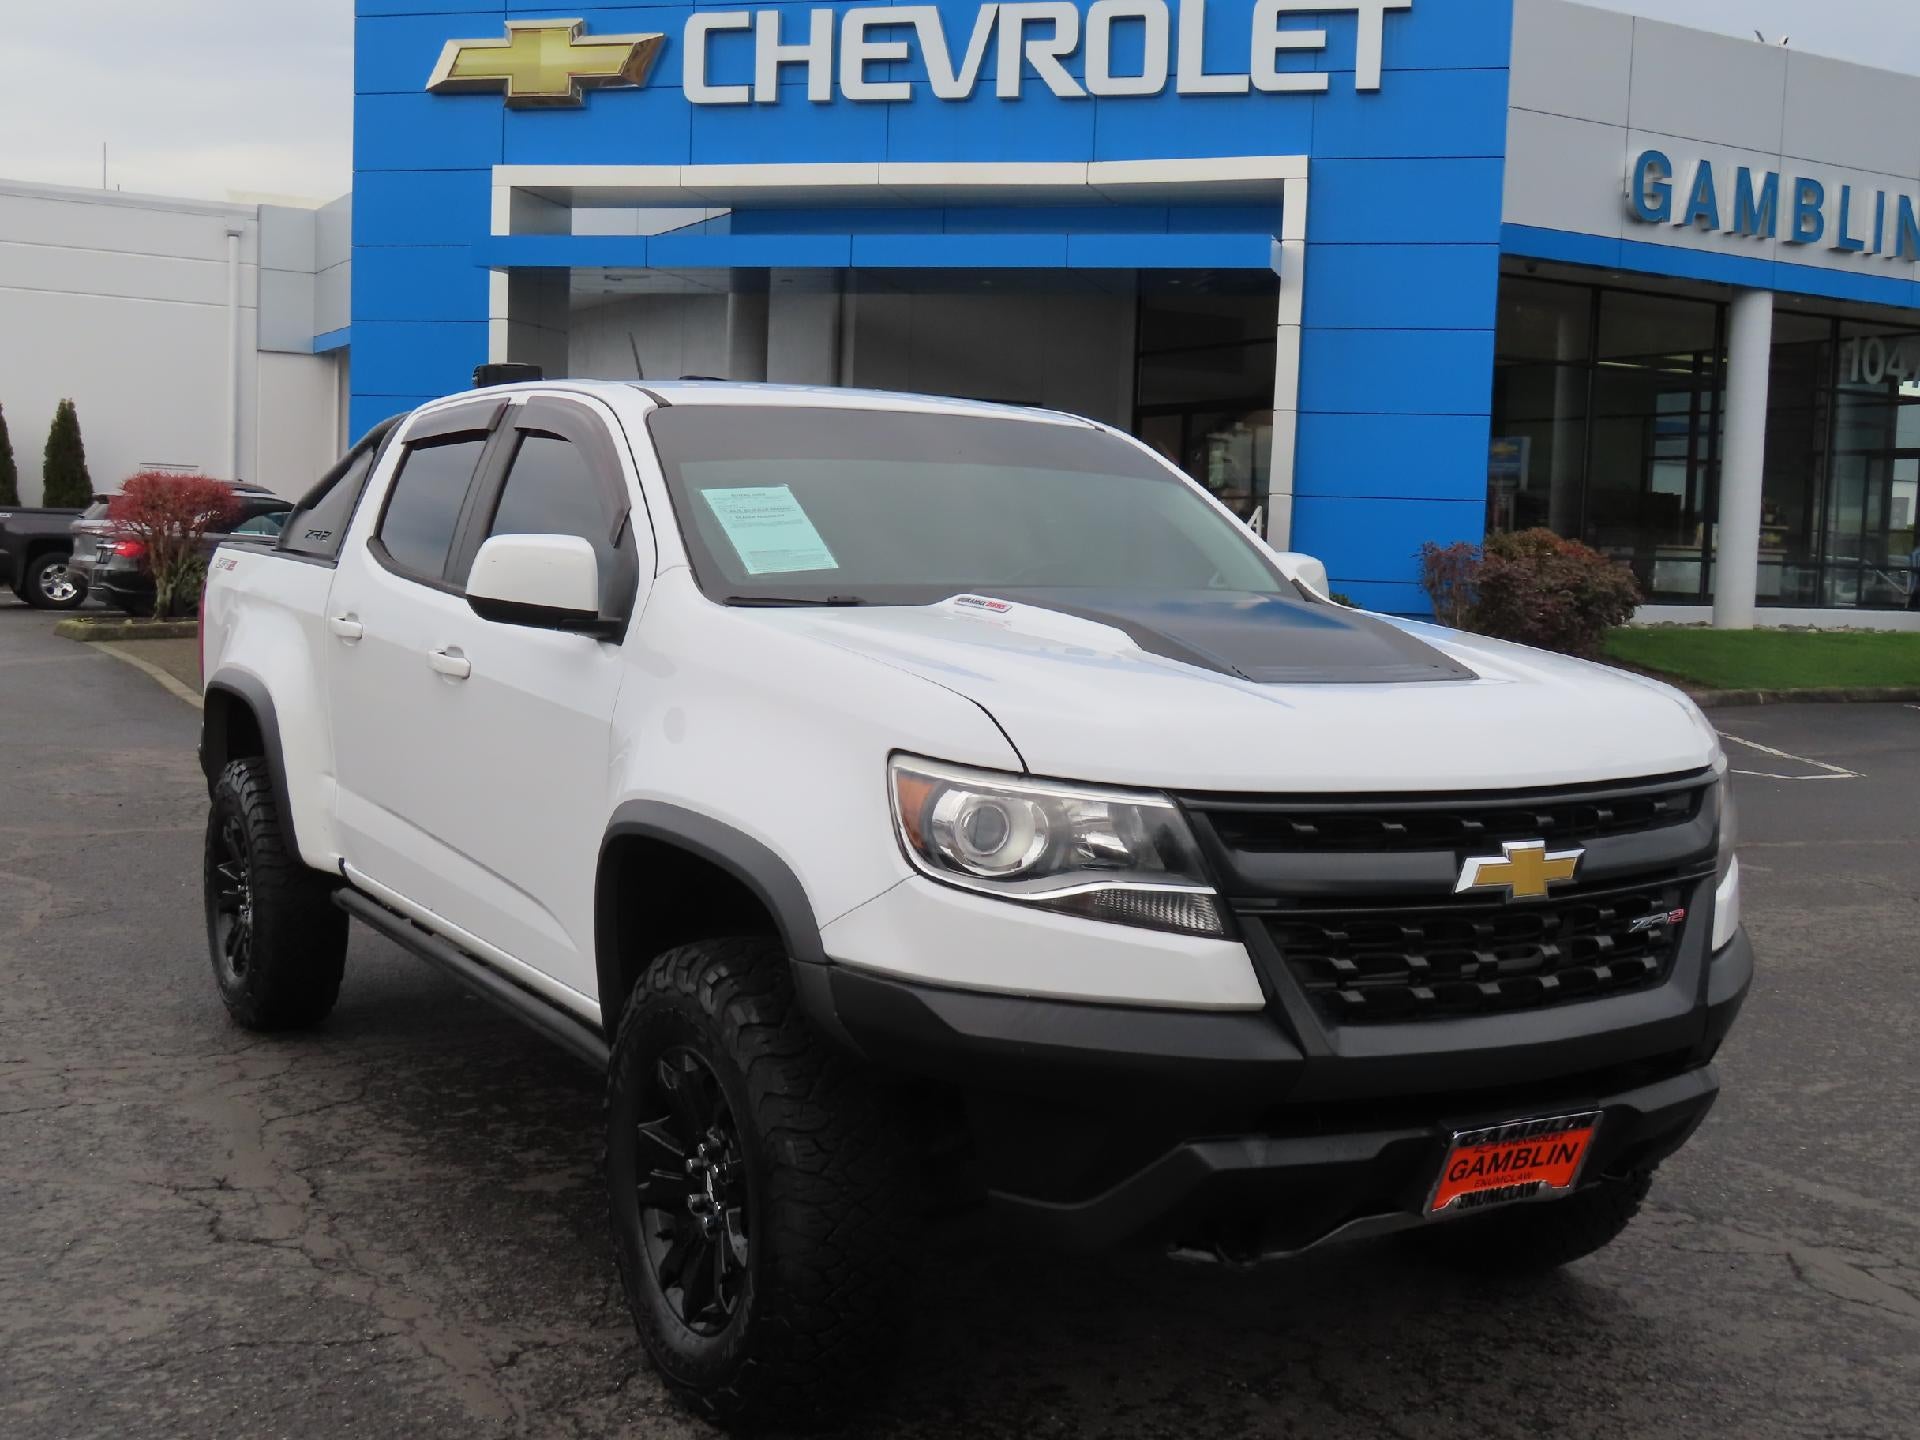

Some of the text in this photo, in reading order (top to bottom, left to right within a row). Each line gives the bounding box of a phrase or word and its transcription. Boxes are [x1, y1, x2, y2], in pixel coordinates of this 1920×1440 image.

[683, 0, 1412, 104] CHEVROLET
[1632, 149, 1920, 261] GAMBLIN
[1846, 336, 1920, 387] 104
[1449, 1142, 1579, 1183] GAMBLIN
[1474, 1171, 1533, 1188] ENUMCLAW
